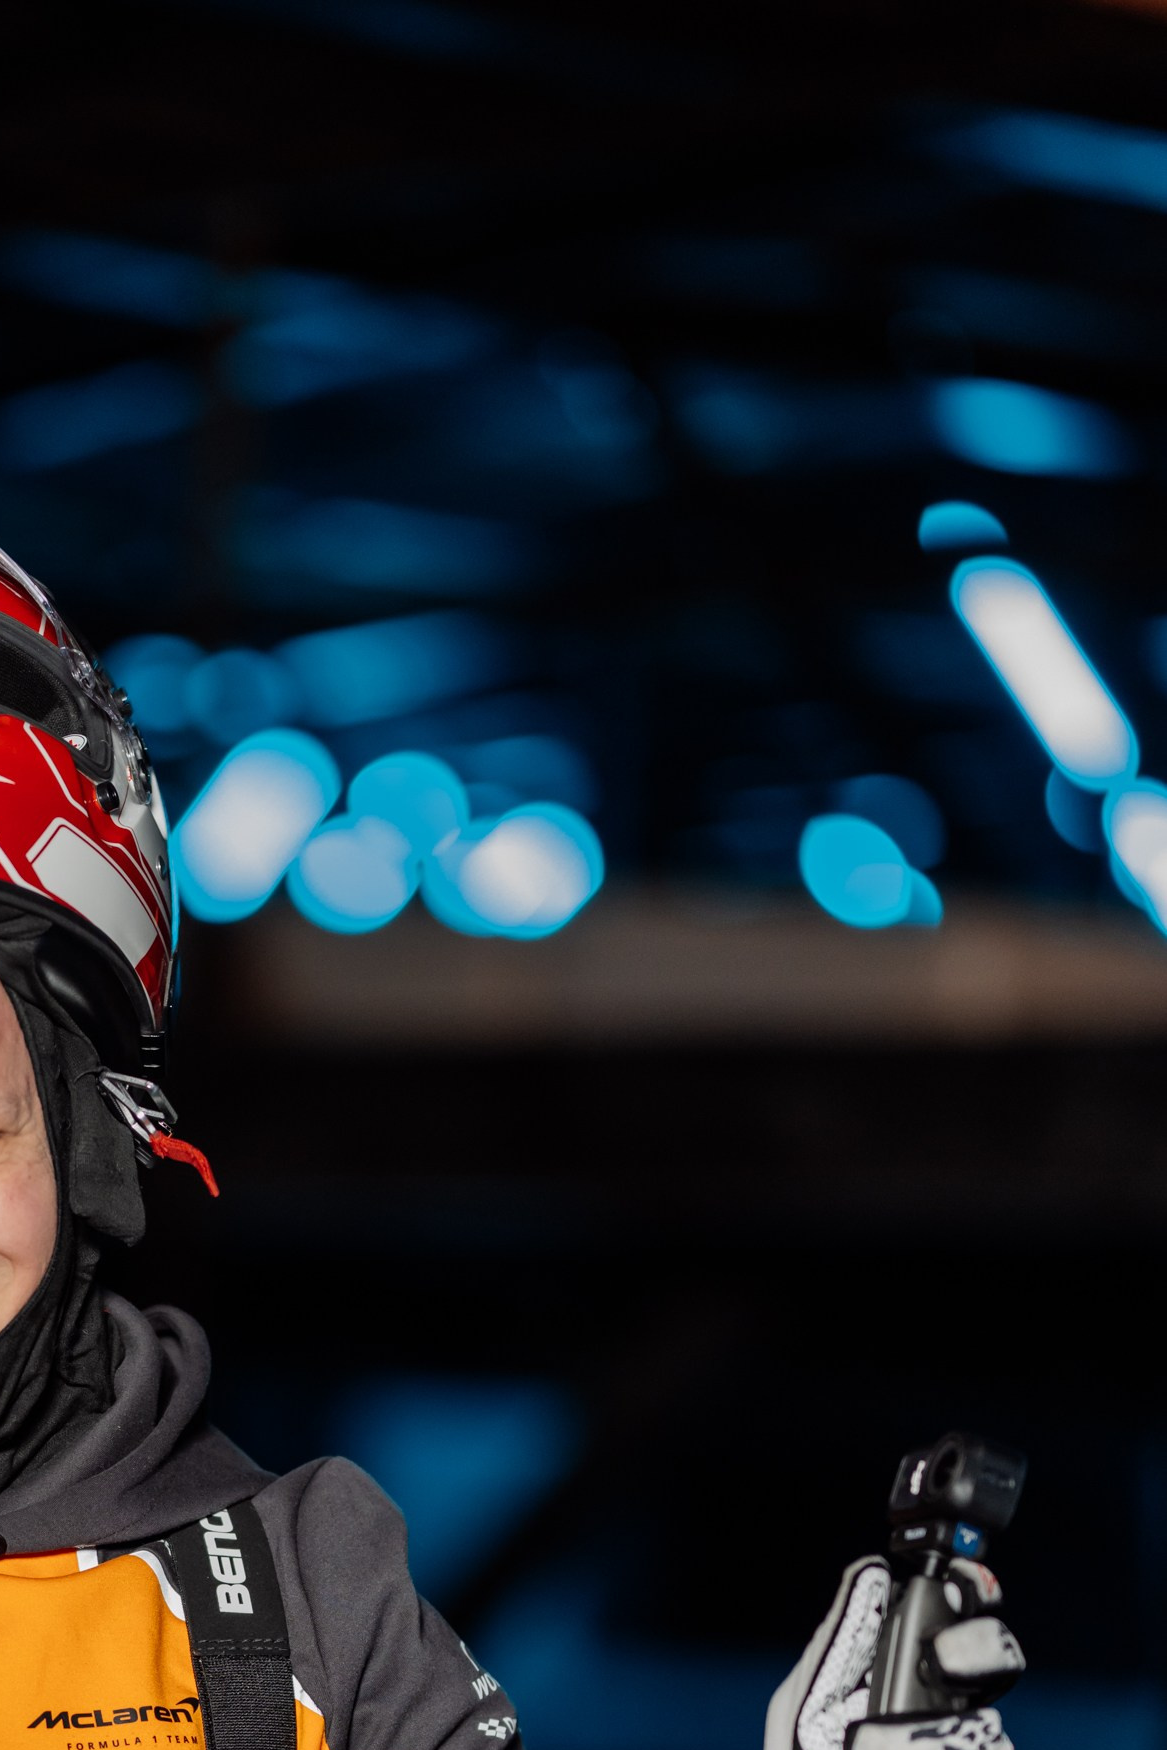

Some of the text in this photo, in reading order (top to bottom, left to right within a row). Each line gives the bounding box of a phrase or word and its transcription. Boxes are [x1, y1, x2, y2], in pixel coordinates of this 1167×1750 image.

[199, 1508, 254, 1615] BENG
[471, 1672, 501, 1701] WO
[27, 1704, 193, 1730] McLaren
[66, 1734, 199, 1750] FORMULA 1 TEAM
